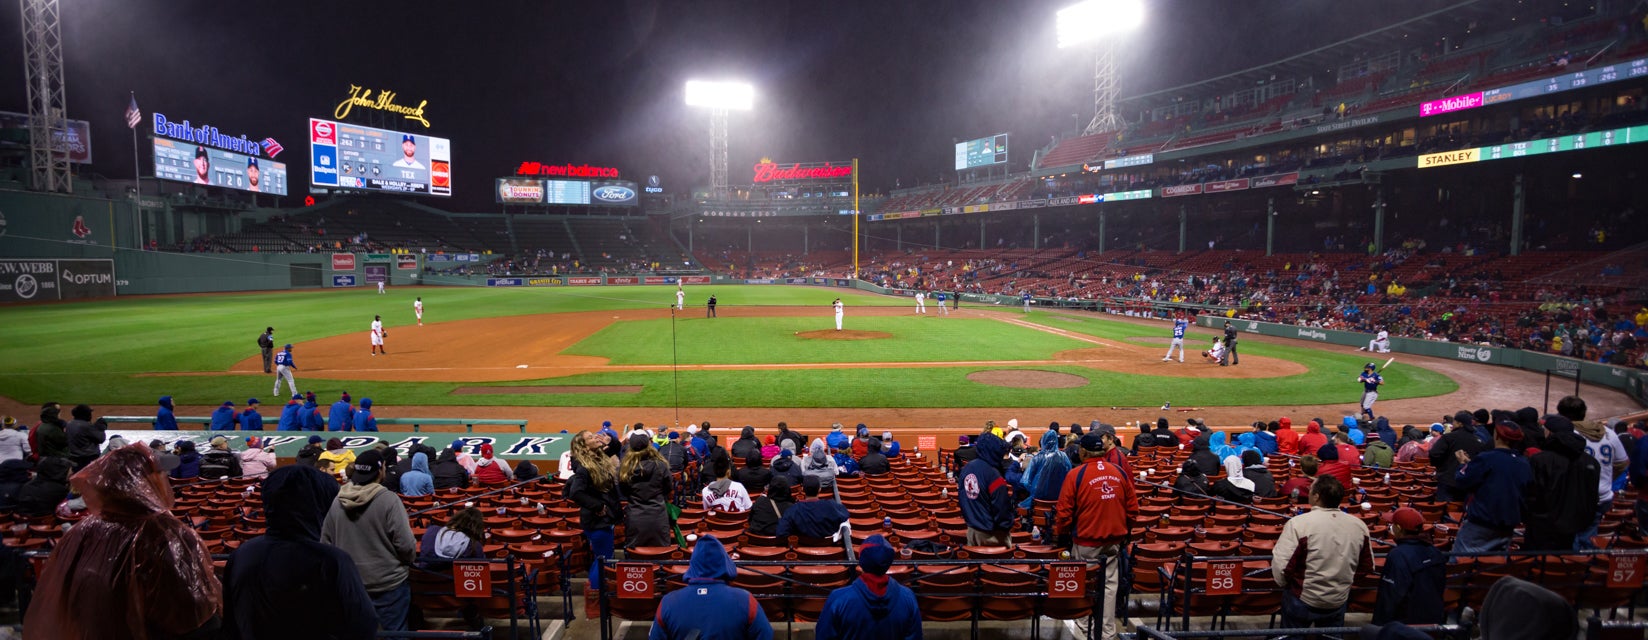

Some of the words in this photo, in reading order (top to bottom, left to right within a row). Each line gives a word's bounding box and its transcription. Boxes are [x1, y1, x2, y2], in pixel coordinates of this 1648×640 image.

[1572, 78, 1586, 86] 139
[334, 83, 376, 120] John
[373, 89, 430, 128] Hancock
[152, 112, 195, 142] Bank
[195, 124, 210, 144] of
[210, 126, 260, 156] America
[1425, 152, 1472, 164] STANLEY
[402, 170, 415, 180] TEX
[541, 165, 568, 176] new
[568, 163, 619, 178] balance
[754, 162, 852, 182] Budweiser
[226, 177, 232, 186] 2
[236, 179, 242, 188] 0
[601, 186, 627, 200] Ford
[19, 262, 54, 274] WEBB
[74, 274, 112, 284] OPTUM
[1458, 352, 1476, 360] Nine
[1088, 476, 1108, 486] FENWAY
[706, 491, 718, 504] BIG
[1612, 570, 1636, 582] 57
[464, 579, 483, 591] 61
[622, 580, 648, 592] 60
[1054, 580, 1079, 592] 59
[1212, 578, 1234, 590] 58
